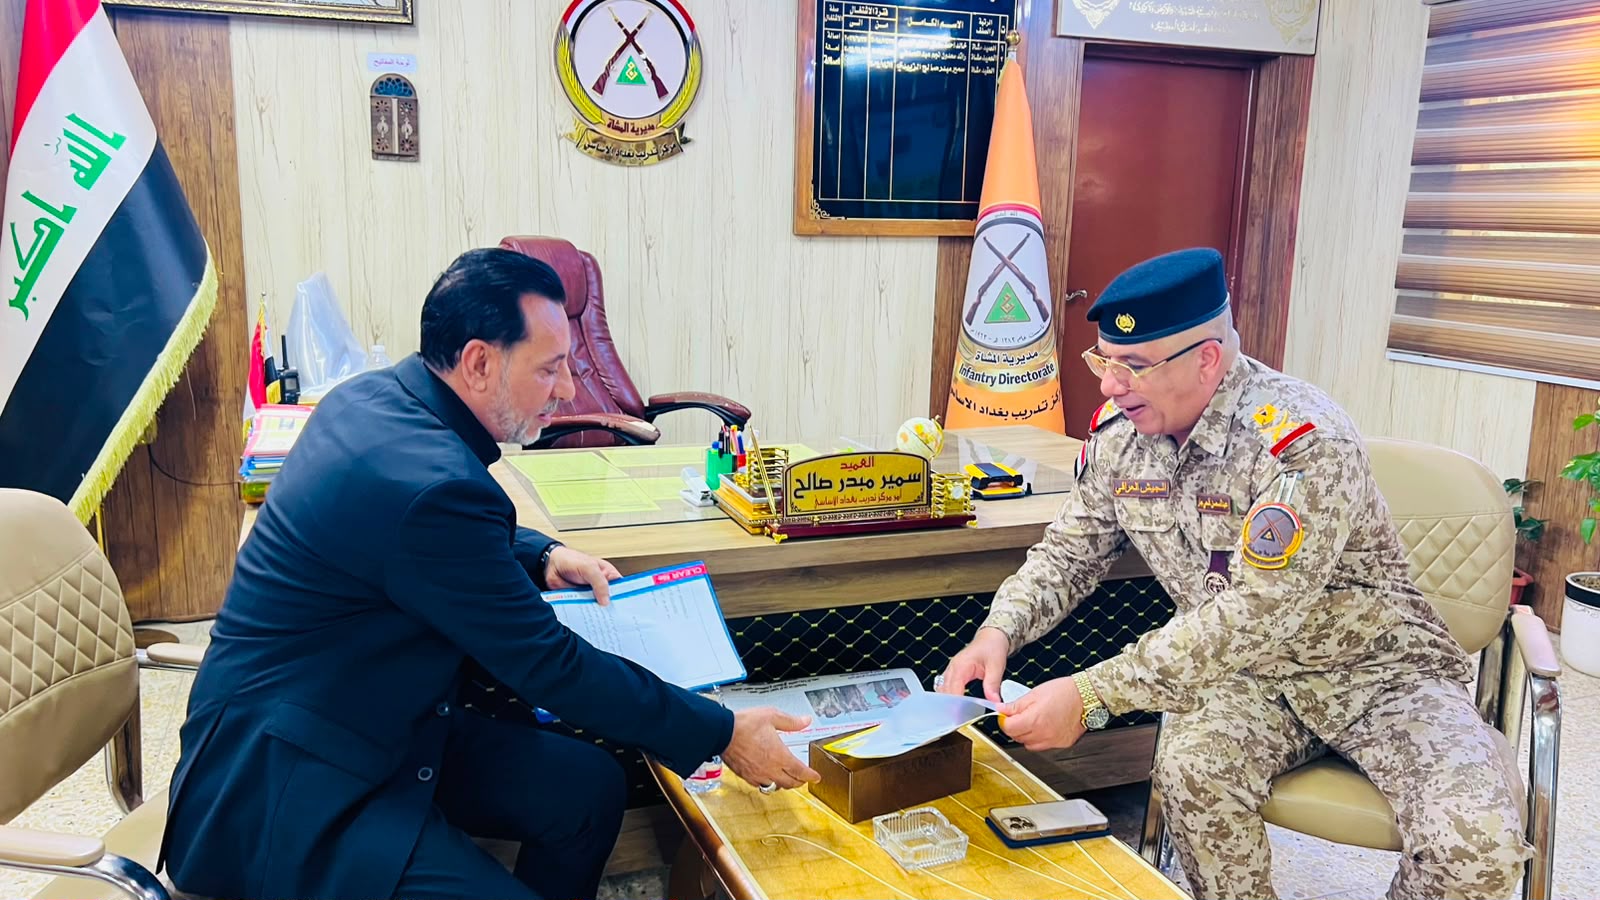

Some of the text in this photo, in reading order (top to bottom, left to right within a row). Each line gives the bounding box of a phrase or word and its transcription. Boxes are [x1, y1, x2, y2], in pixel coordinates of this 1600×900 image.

[875, 20, 889, 30] من
[907, 16, 964, 29] الاسم الكامل
[607, 118, 656, 136] مديرية المشاة
[44, 113, 127, 191] الله
[615, 148, 635, 158] بغداد
[636, 147, 659, 160] تدريب
[660, 142, 677, 156] مركز
[975, 350, 1039, 366] مديرية المشاة
[959, 363, 1055, 387] Infantry Directorate
[979, 406, 1009, 420] بغداد
[1011, 400, 1048, 420] تدريب
[840, 456, 875, 472] العميد
[794, 472, 921, 499] سمير مبدر صالح
[1140, 481, 1167, 494] الجيش
[672, 567, 703, 580] CLEAR
